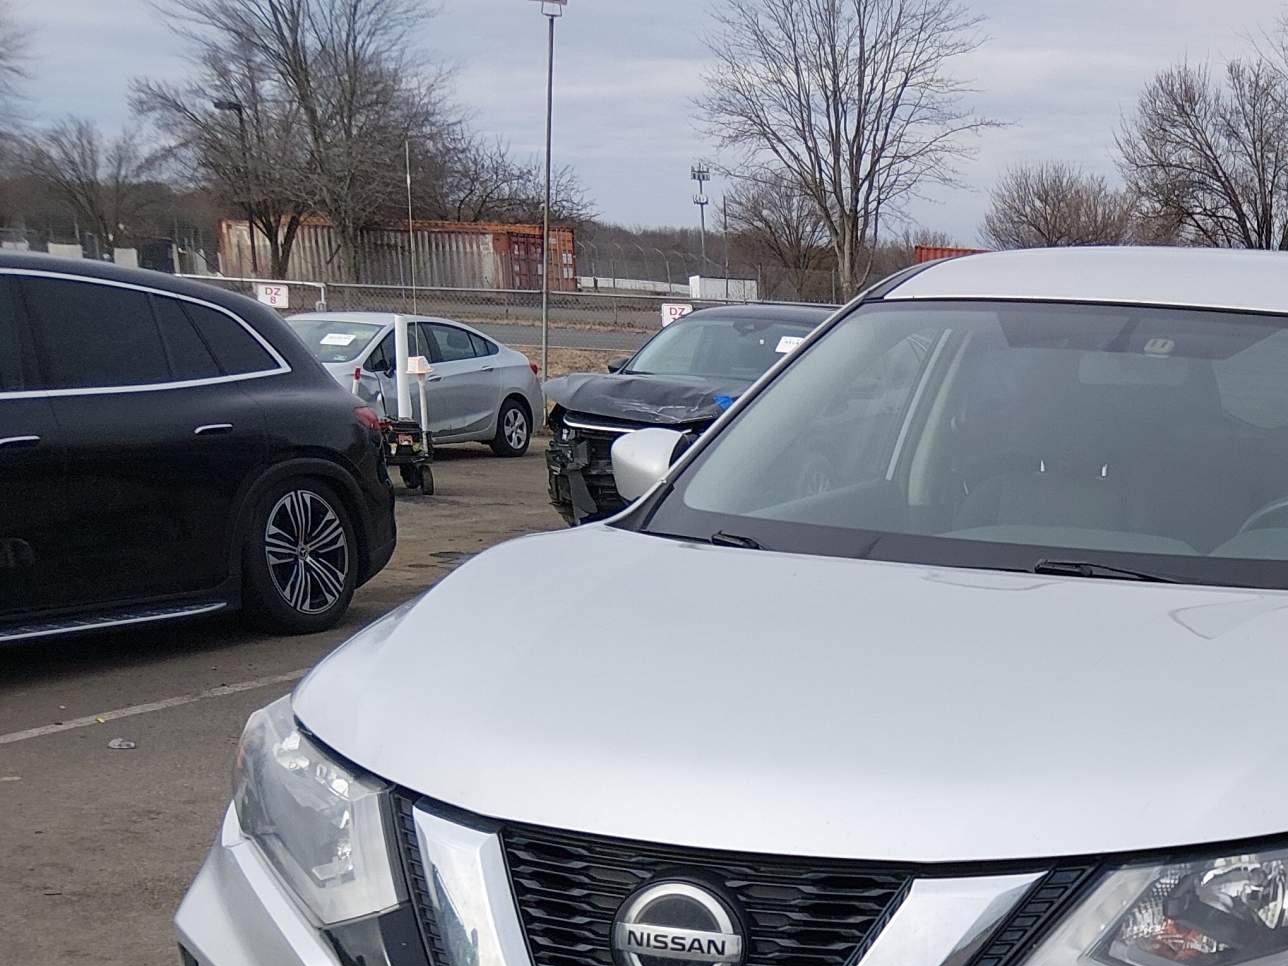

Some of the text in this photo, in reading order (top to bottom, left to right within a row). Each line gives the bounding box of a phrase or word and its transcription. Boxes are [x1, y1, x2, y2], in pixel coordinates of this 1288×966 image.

[265, 287, 281, 296] DZ
[669, 307, 686, 317] DZ
[627, 930, 726, 956] NISSAN
